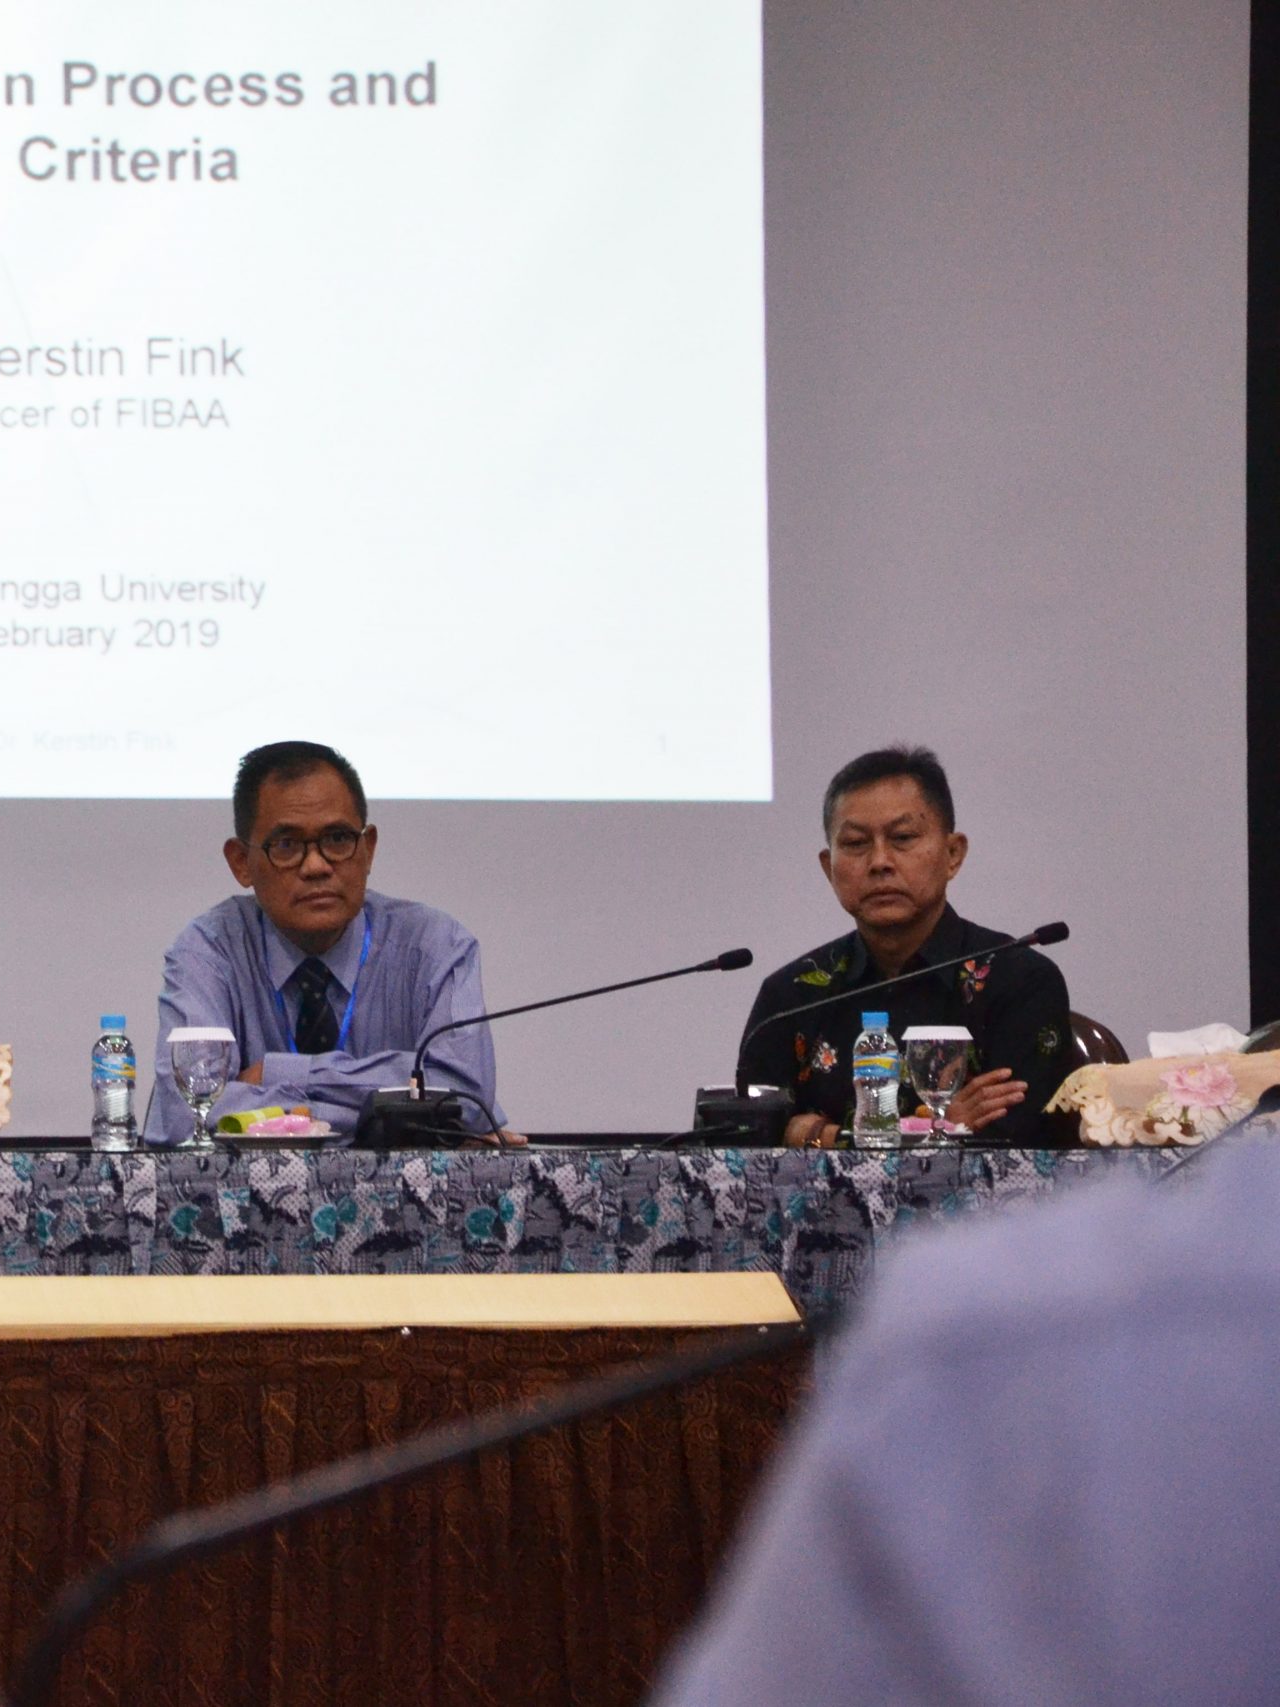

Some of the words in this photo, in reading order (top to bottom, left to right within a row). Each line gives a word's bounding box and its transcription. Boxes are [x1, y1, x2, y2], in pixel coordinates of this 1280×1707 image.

[62, 60, 305, 108] Process
[328, 60, 437, 108] and
[18, 135, 238, 183] Criteria
[146, 336, 246, 377] Fink
[69, 398, 103, 429] of
[115, 397, 231, 430] FIBAA
[100, 573, 267, 611] University
[133, 617, 221, 649] 2019
[33, 730, 118, 751] Kerstin
[125, 730, 177, 751] Fink
